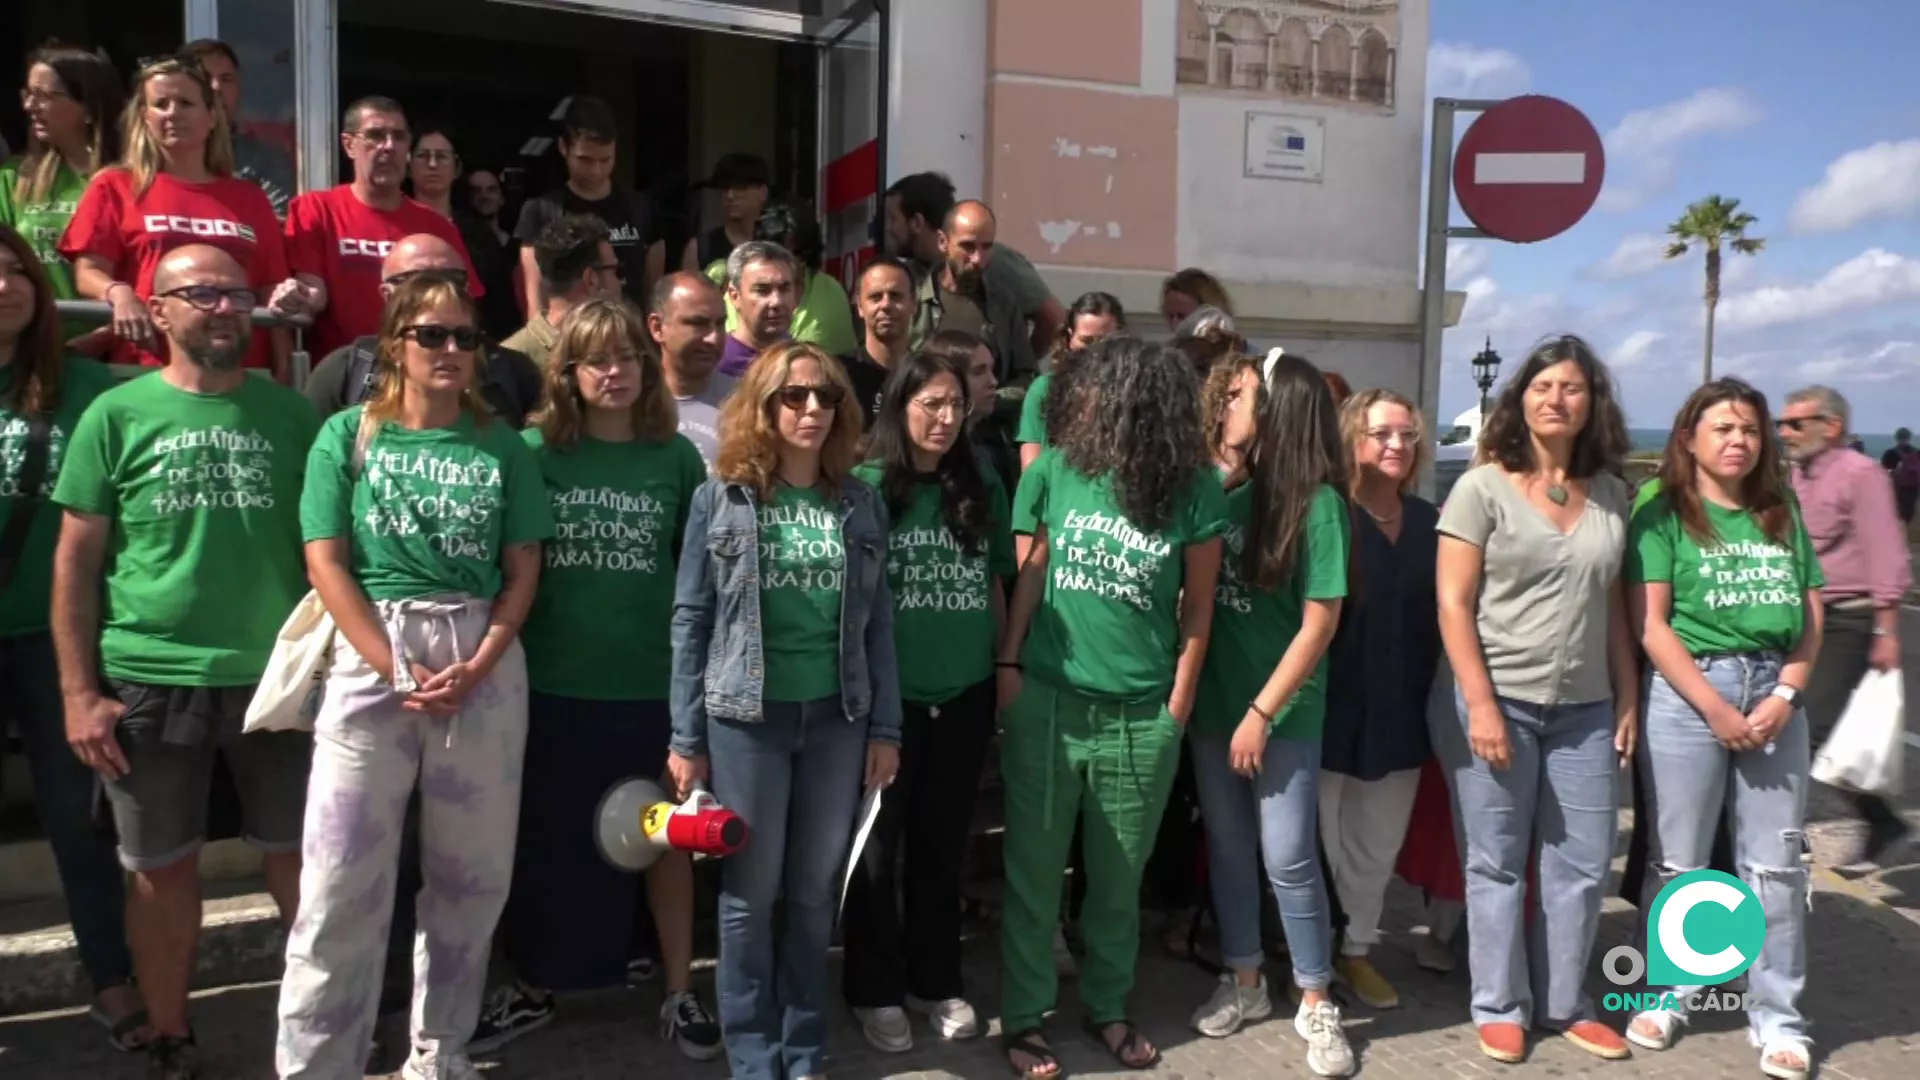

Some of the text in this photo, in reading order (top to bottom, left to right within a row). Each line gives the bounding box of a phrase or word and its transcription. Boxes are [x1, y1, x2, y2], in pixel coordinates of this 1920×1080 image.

[556, 523, 587, 540] DE
[1067, 546, 1094, 565] DE
[904, 565, 932, 582] DE
[1055, 570, 1096, 590] PARA
